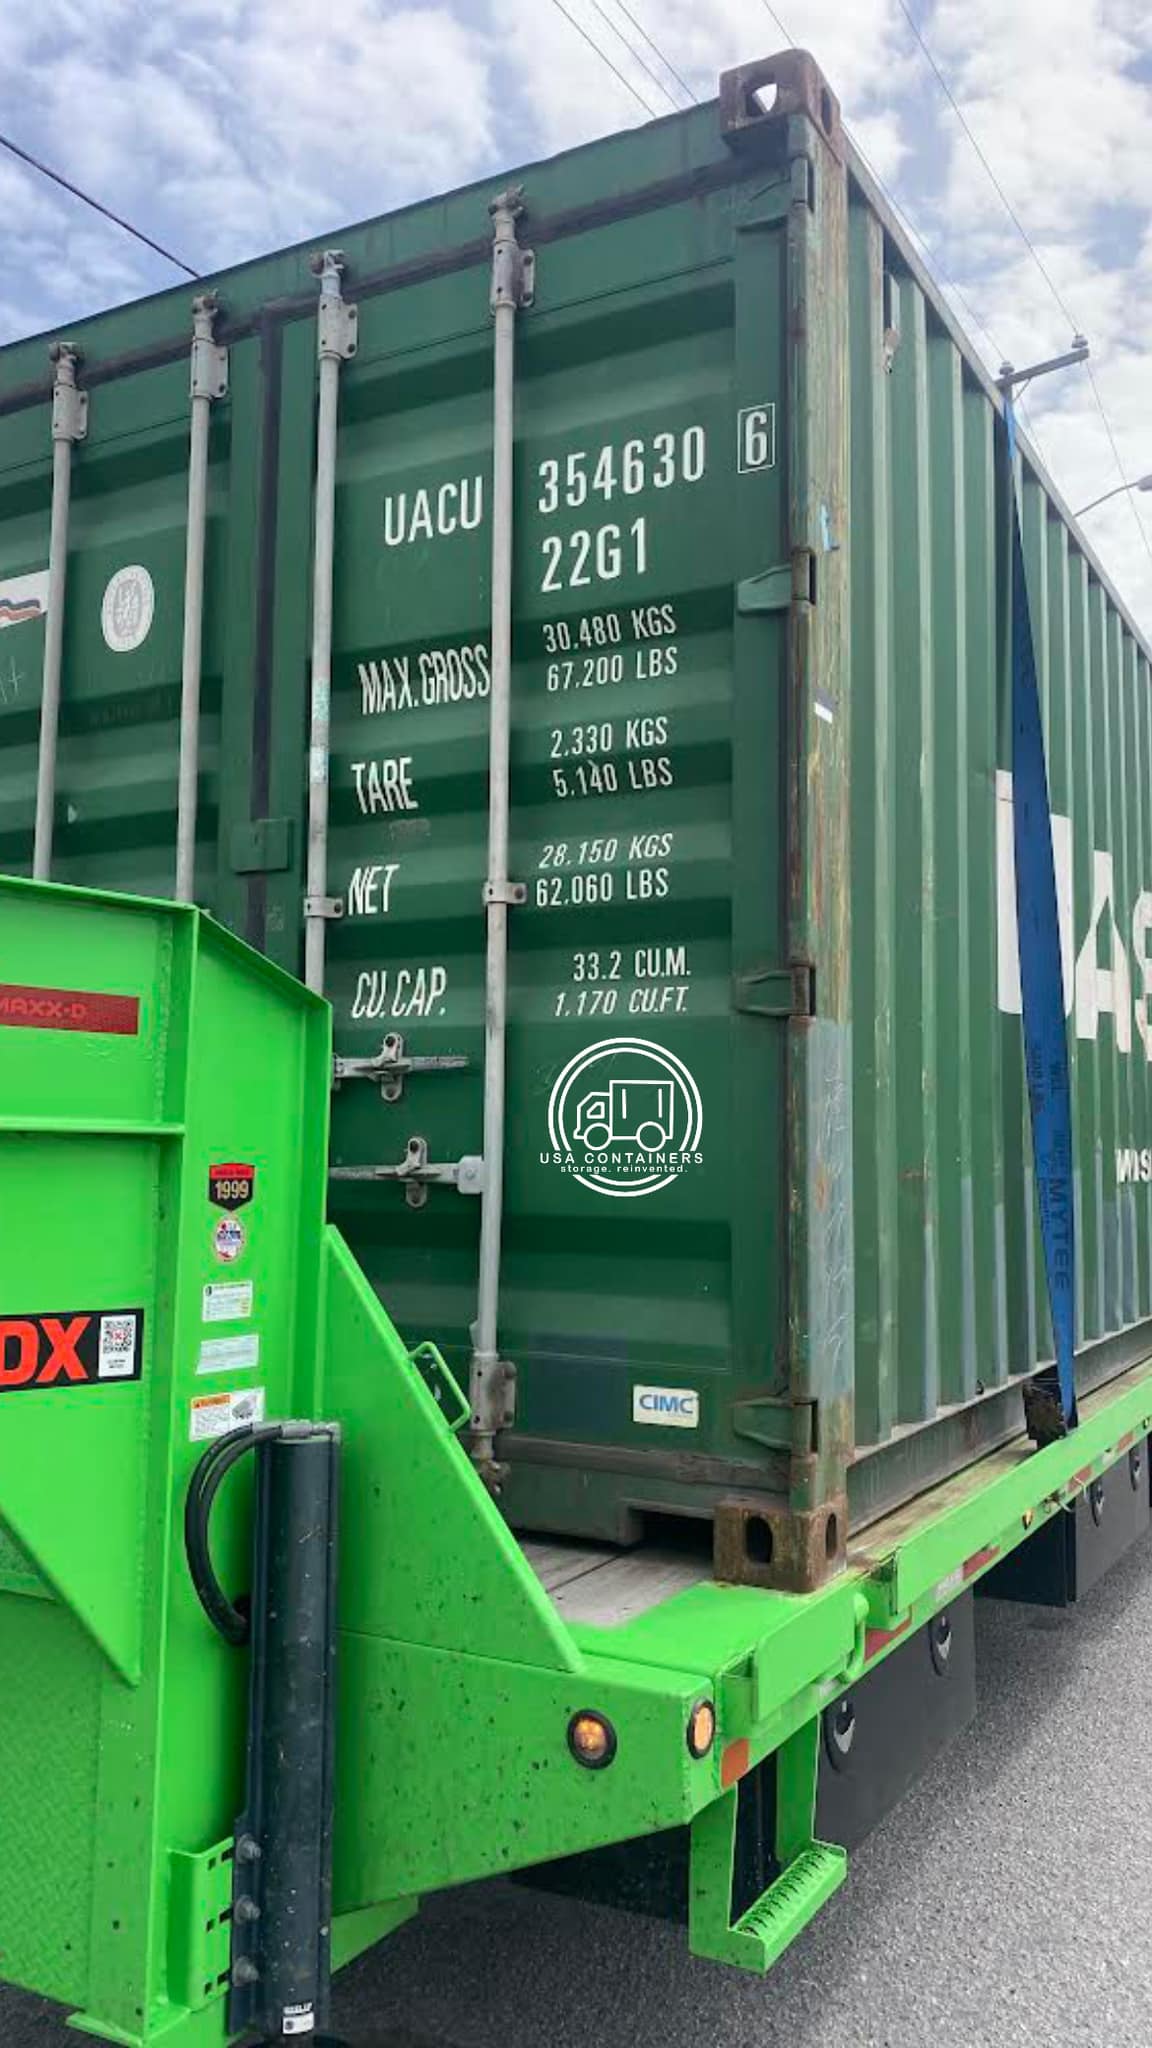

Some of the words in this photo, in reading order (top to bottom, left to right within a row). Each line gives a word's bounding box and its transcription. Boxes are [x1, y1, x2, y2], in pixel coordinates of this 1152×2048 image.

[385, 476, 482, 546] UACU
[539, 426, 705, 513] 354630
[745, 411, 768, 466] 6
[539, 518, 646, 592] 22G1
[543, 614, 621, 652] 30.480
[632, 605, 676, 639] KGS
[548, 654, 623, 691] 67.200
[637, 646, 677, 679] LBS
[551, 723, 612, 758] 2.330
[626, 717, 667, 748] KGS
[351, 757, 418, 813] TARE
[553, 761, 617, 797] 5.140
[629, 757, 672, 789] LBS
[539, 838, 618, 869] 28.150
[629, 833, 673, 860] KGS
[349, 864, 400, 915] NET
[537, 873, 612, 908] 62.060
[627, 868, 668, 899] LBS
[574, 950, 621, 981] 33.2
[555, 990, 617, 1016] 1.170
[215, 1180, 249, 1199] 1999
[639, 1394, 694, 1414] CIMC
